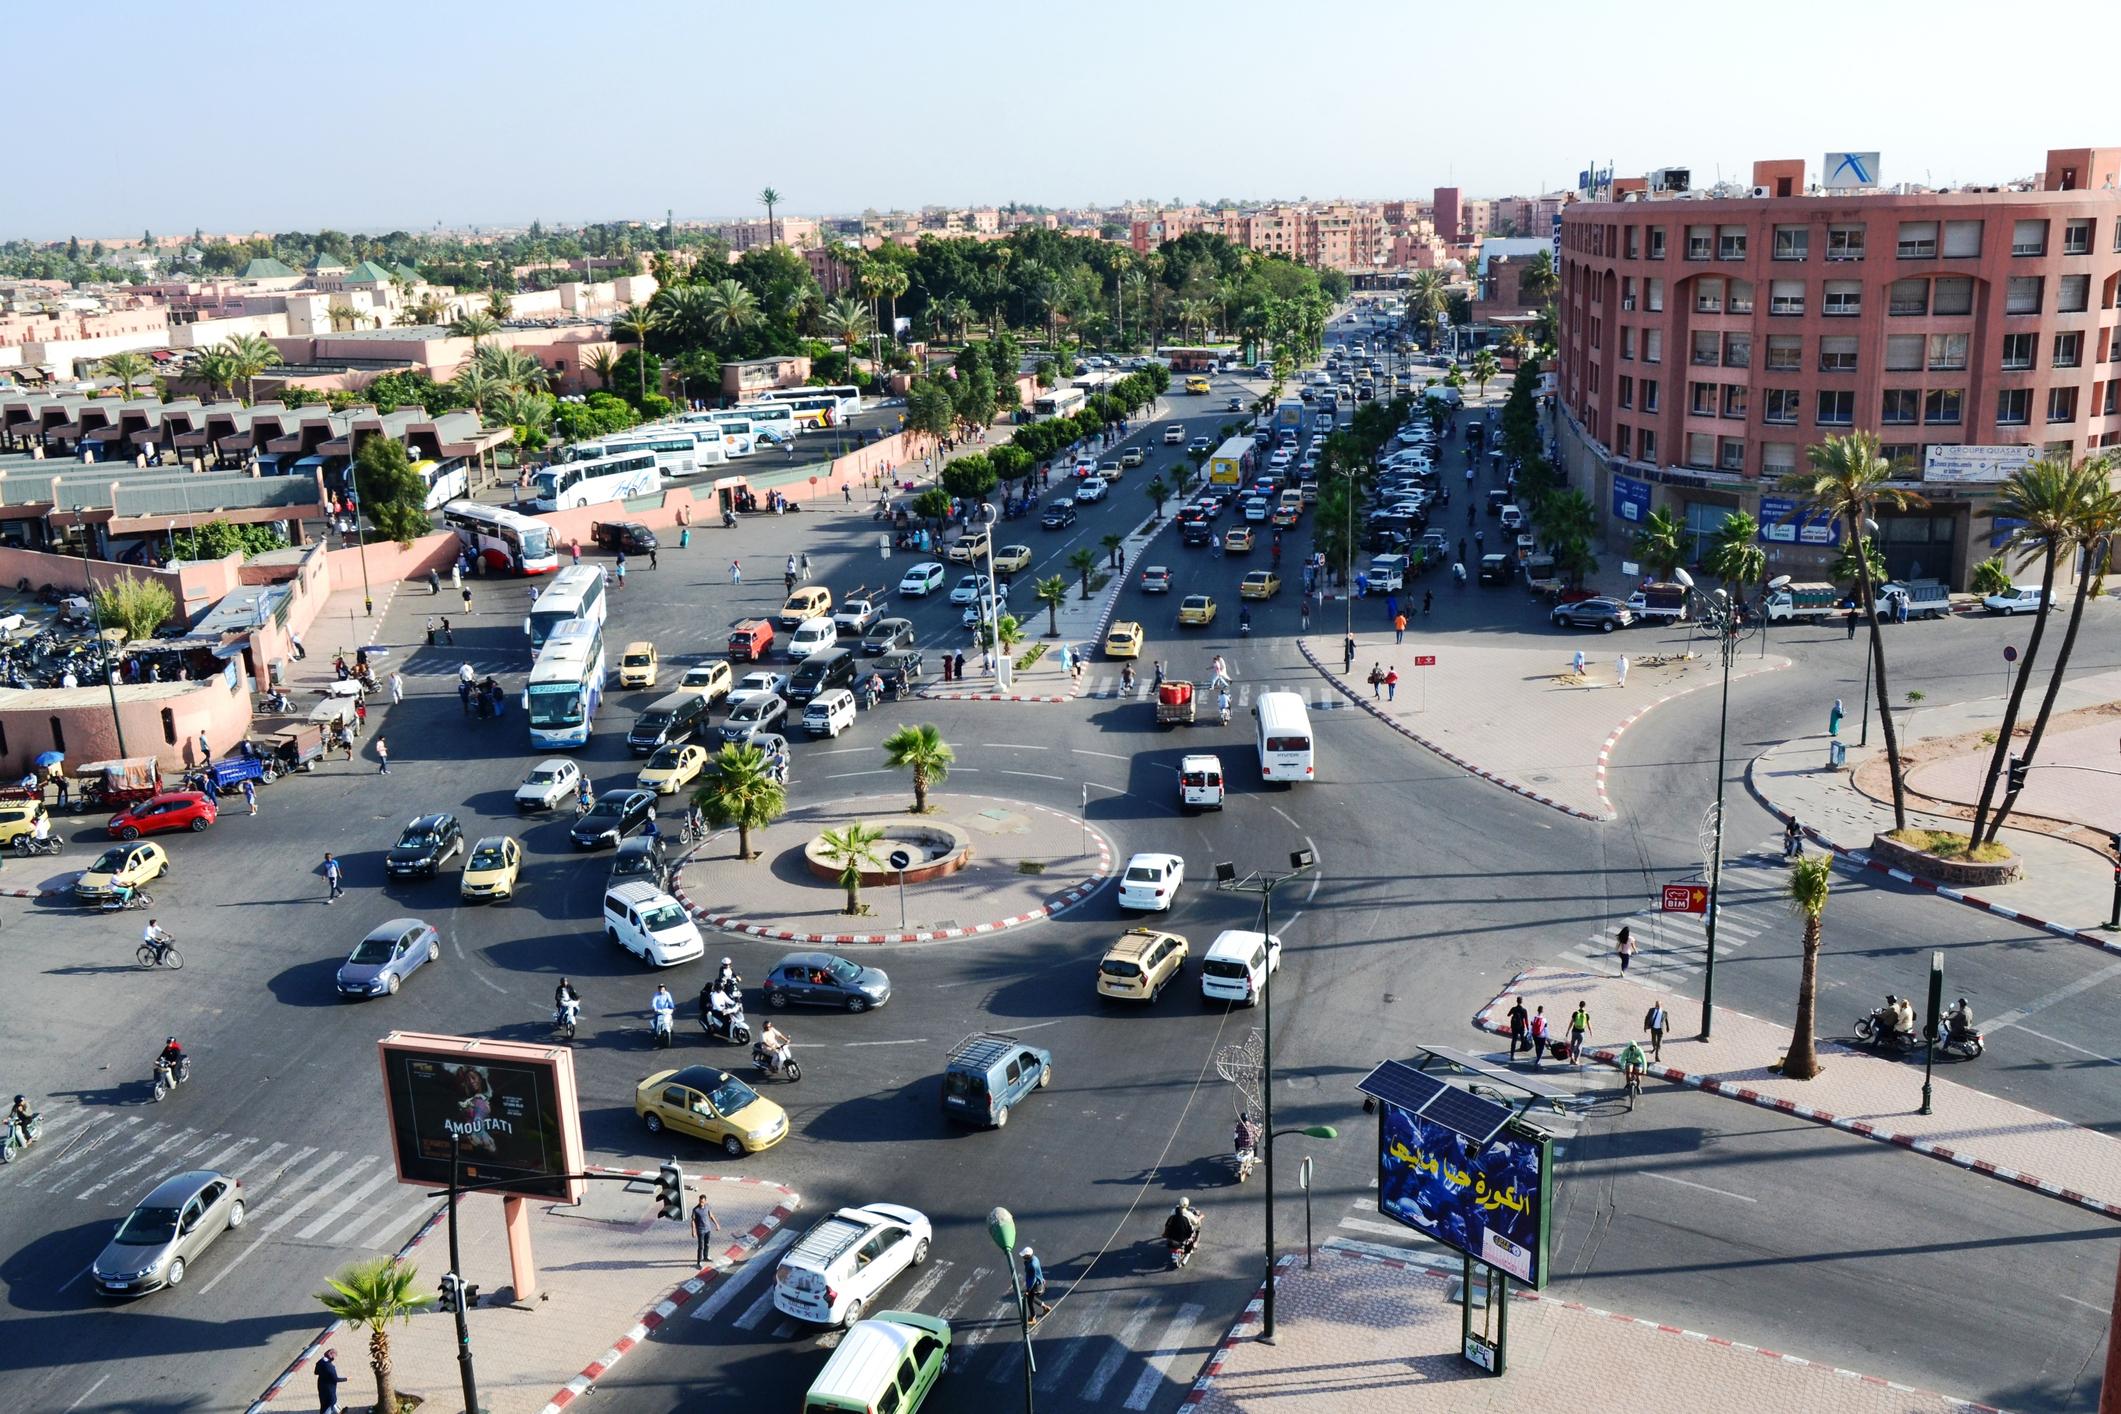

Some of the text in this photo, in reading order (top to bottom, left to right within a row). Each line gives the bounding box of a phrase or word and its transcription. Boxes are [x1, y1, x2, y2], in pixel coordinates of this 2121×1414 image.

[1553, 226, 1561, 273] HOTEL
[1949, 446, 2022, 455] GROUPE QUASAR
